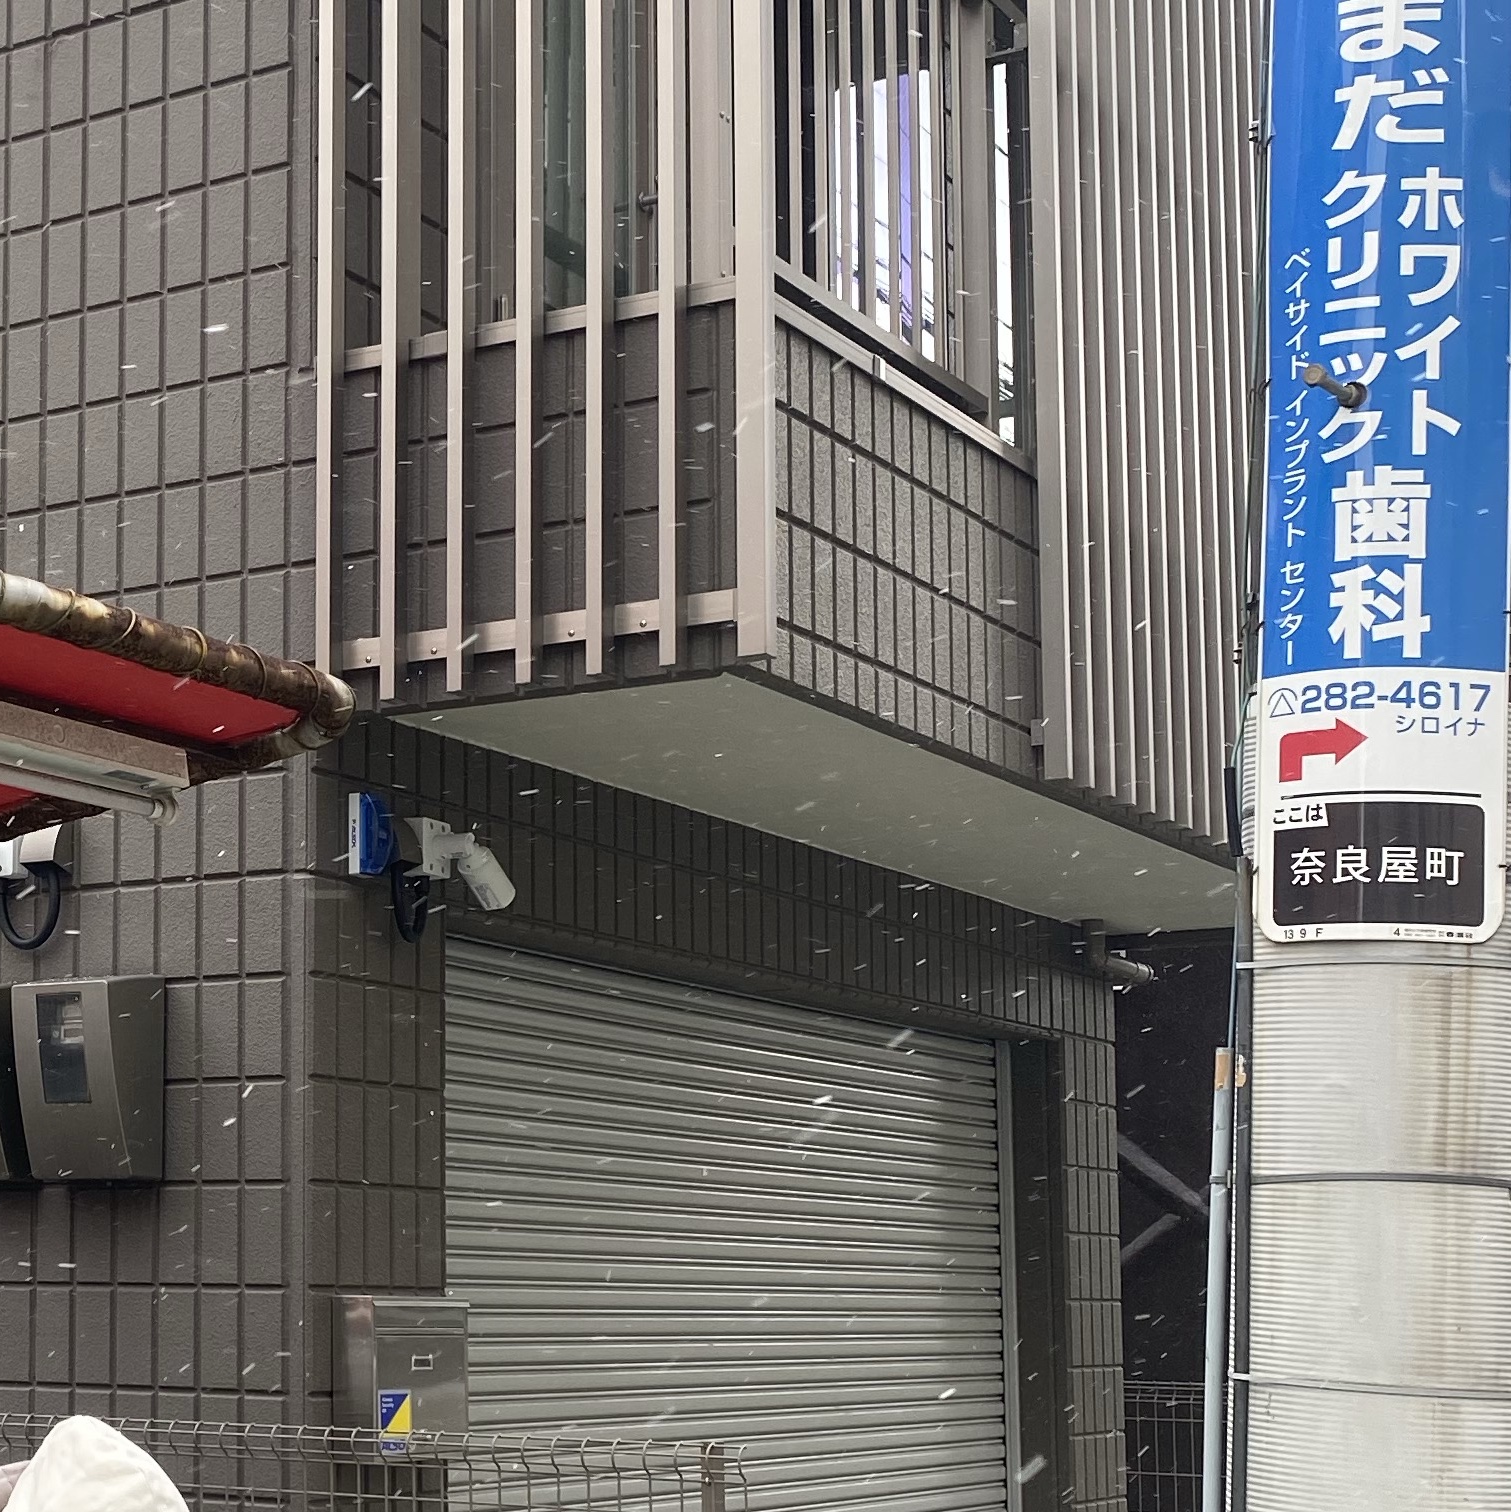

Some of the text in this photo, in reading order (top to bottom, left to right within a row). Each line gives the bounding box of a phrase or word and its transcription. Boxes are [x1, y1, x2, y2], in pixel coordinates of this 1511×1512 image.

[1317, 169, 1388, 464] クリニック
[1394, 166, 1465, 456] ホワイト
[1279, 247, 1312, 666] ベイサイド インプラント センター
[1328, 464, 1431, 660] 歯科
[1300, 680, 1492, 714] 282-4617
[1395, 714, 1486, 737] シロイナ
[1273, 803, 1324, 825] ここは
[1289, 845, 1466, 887] 奈良屋町
